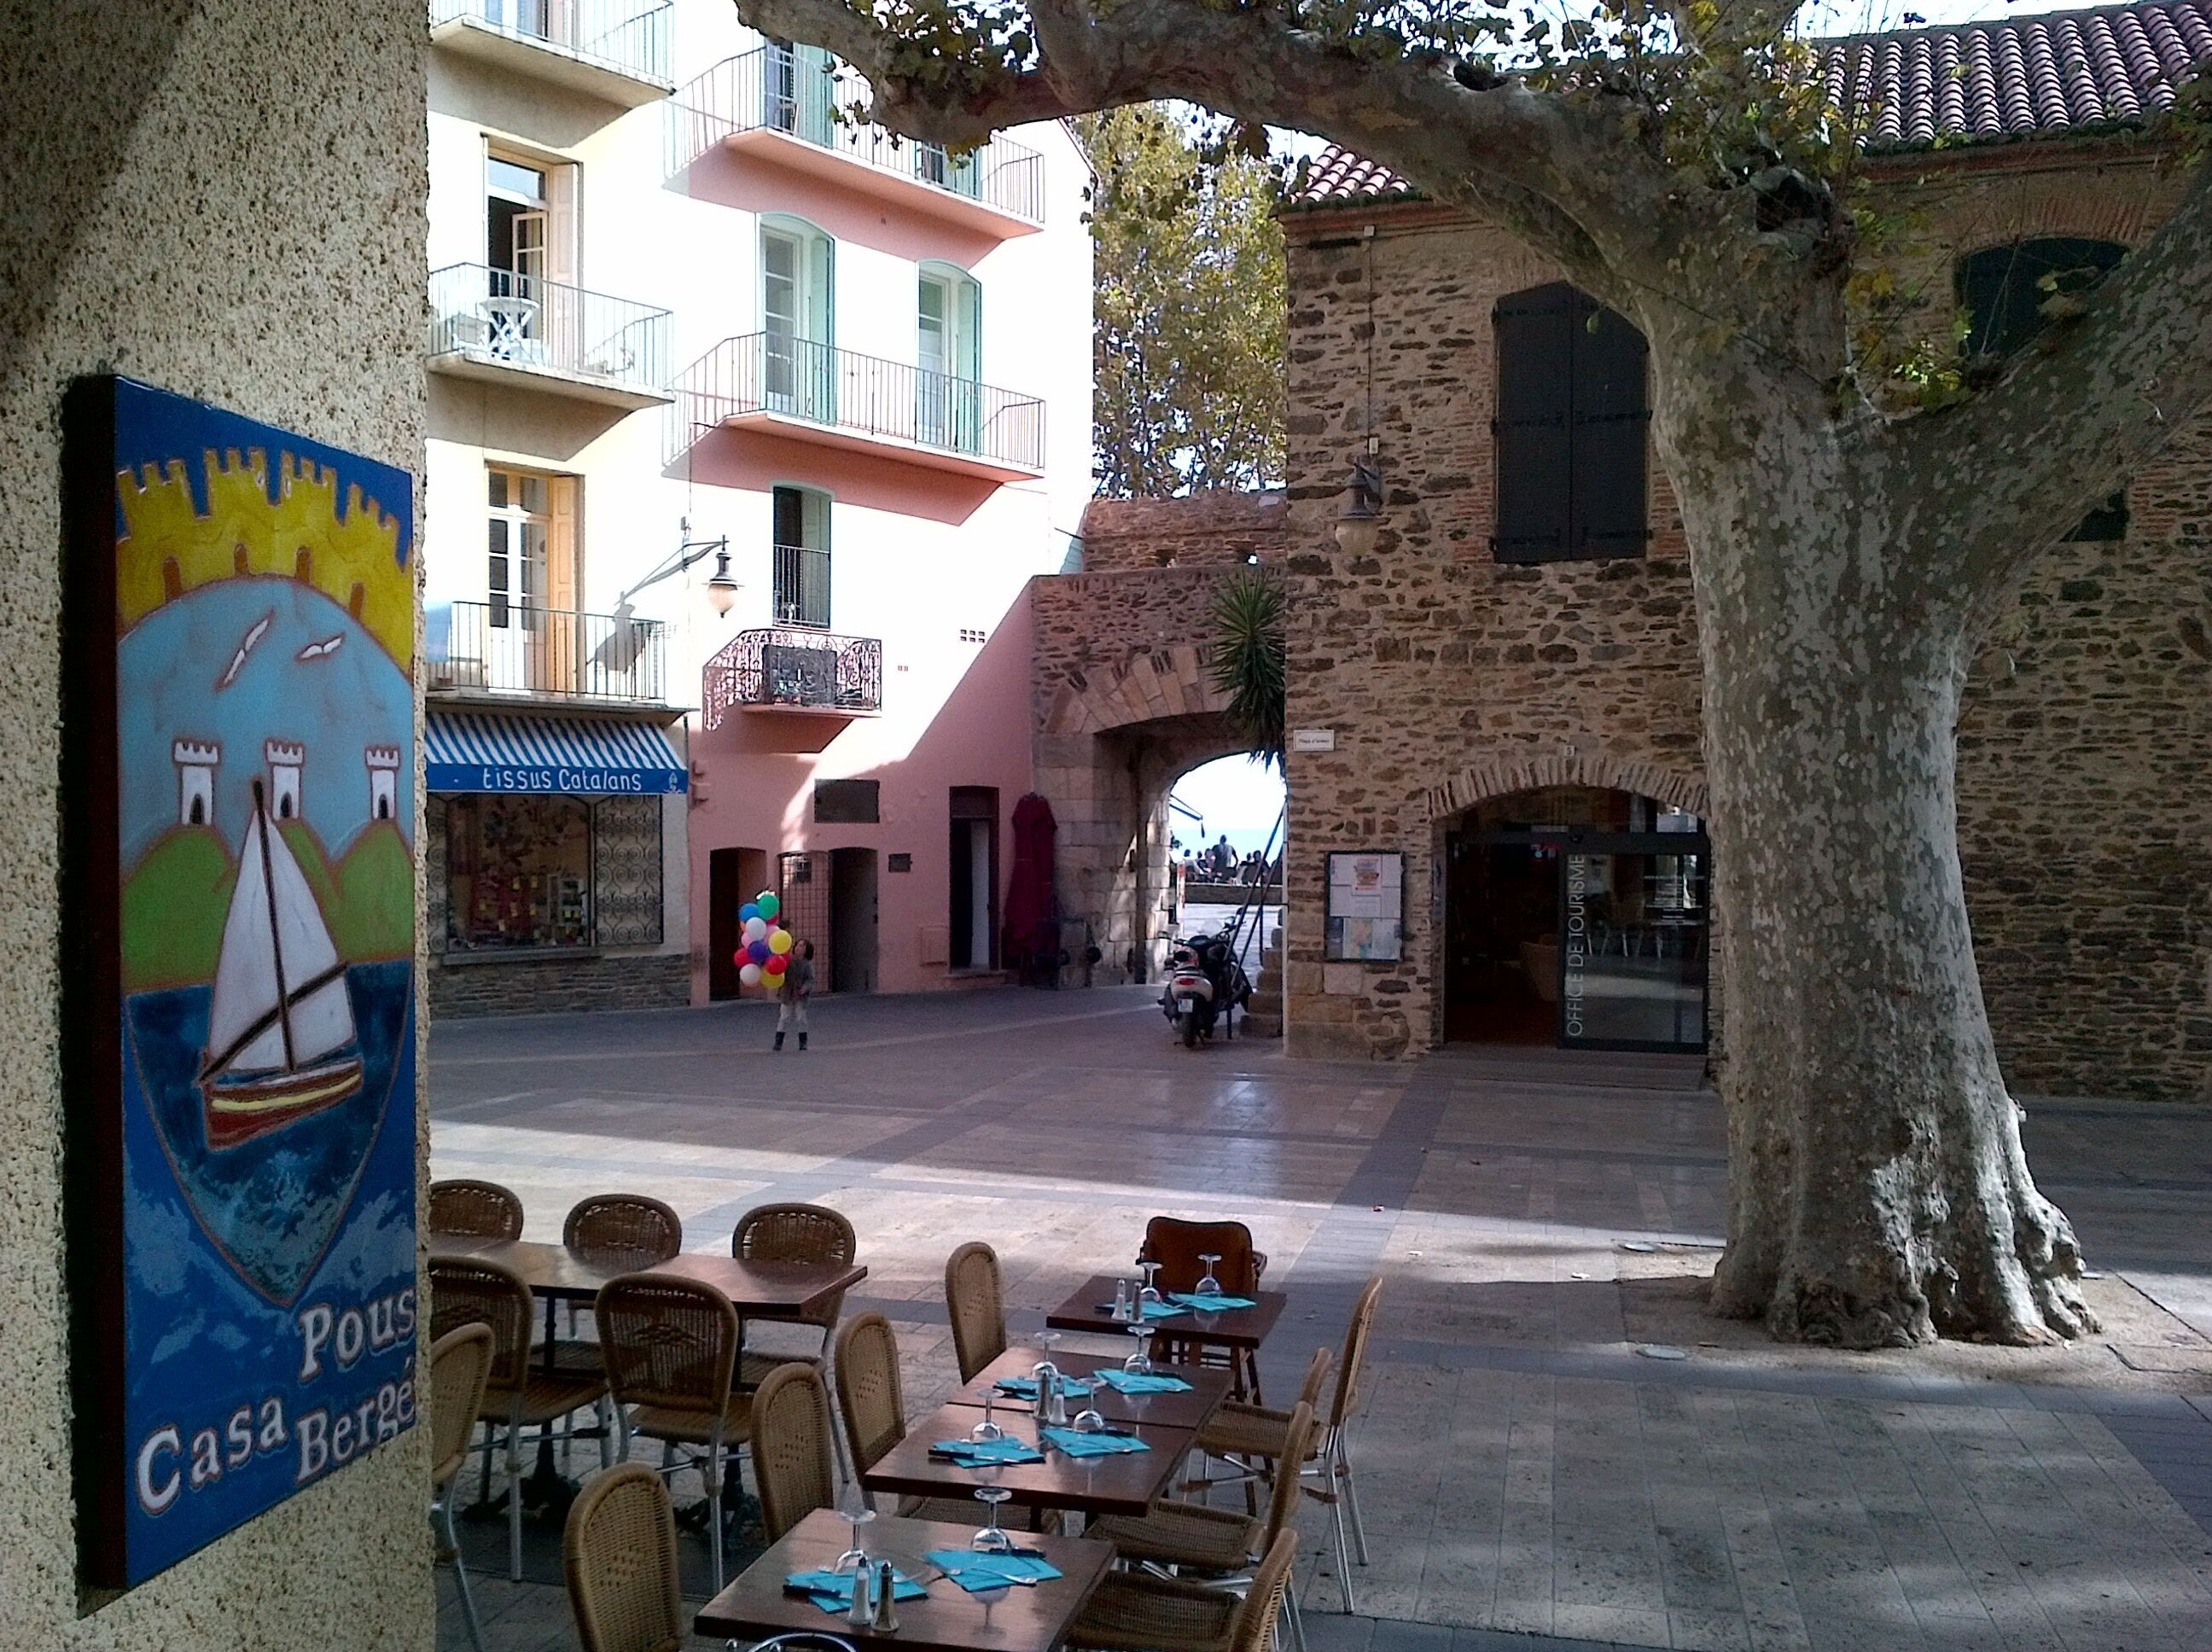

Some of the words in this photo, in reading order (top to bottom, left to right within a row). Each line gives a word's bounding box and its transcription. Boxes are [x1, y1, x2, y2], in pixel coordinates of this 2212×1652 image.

[483, 768, 552, 790] tissus
[558, 768, 642, 792] Catalans
[1569, 854, 1585, 938] TOURISME
[1569, 945, 1584, 967] DE
[1567, 974, 1584, 1037] OFFICE
[300, 1288, 416, 1381] Pous
[137, 1396, 288, 1513] Casa
